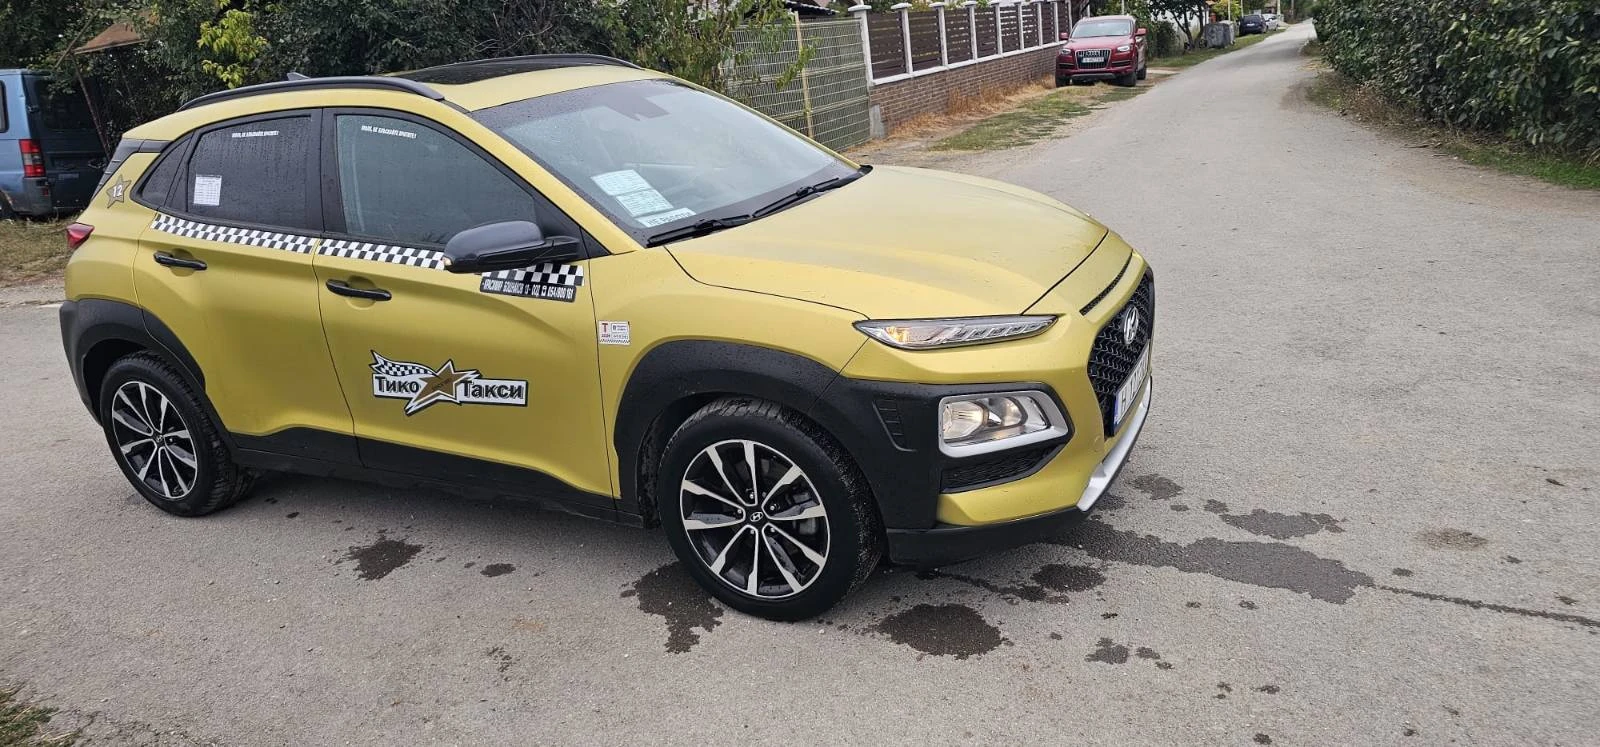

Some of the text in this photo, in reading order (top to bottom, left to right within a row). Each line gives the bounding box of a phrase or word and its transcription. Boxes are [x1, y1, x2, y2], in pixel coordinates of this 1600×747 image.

[113, 184, 123, 198] 12
[375, 376, 421, 393] Тико
[460, 380, 525, 399] Такси
